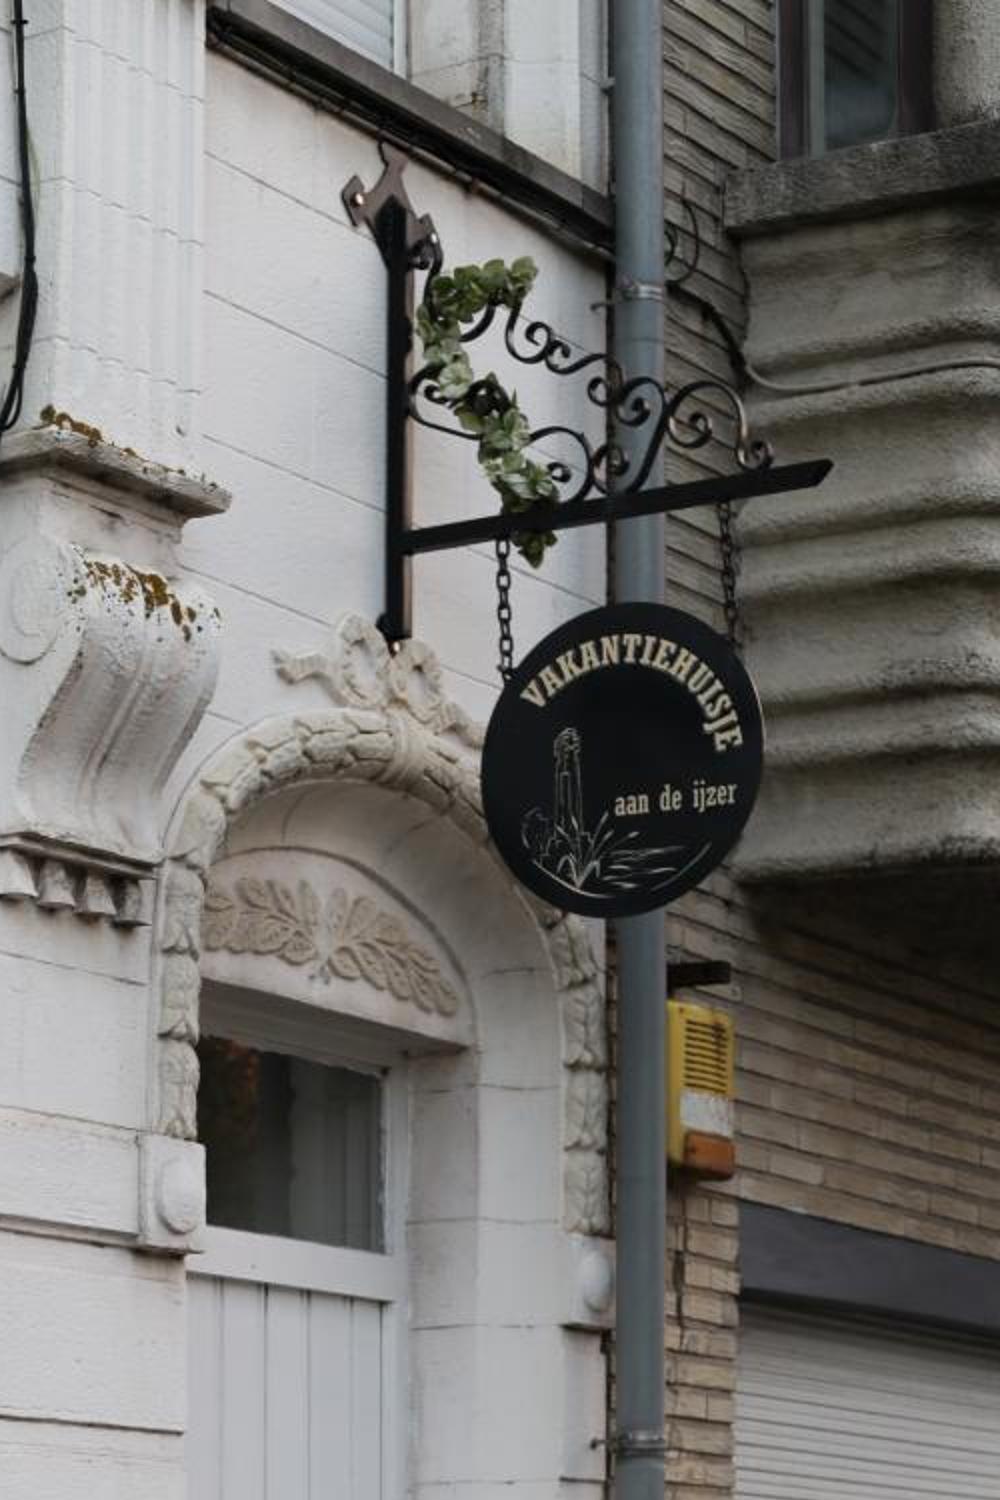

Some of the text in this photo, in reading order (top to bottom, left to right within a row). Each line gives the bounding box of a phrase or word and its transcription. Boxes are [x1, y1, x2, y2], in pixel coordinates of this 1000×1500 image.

[520, 633, 743, 751] VAKANTIEHUISJE
[615, 780, 737, 816] aan de ijzer
